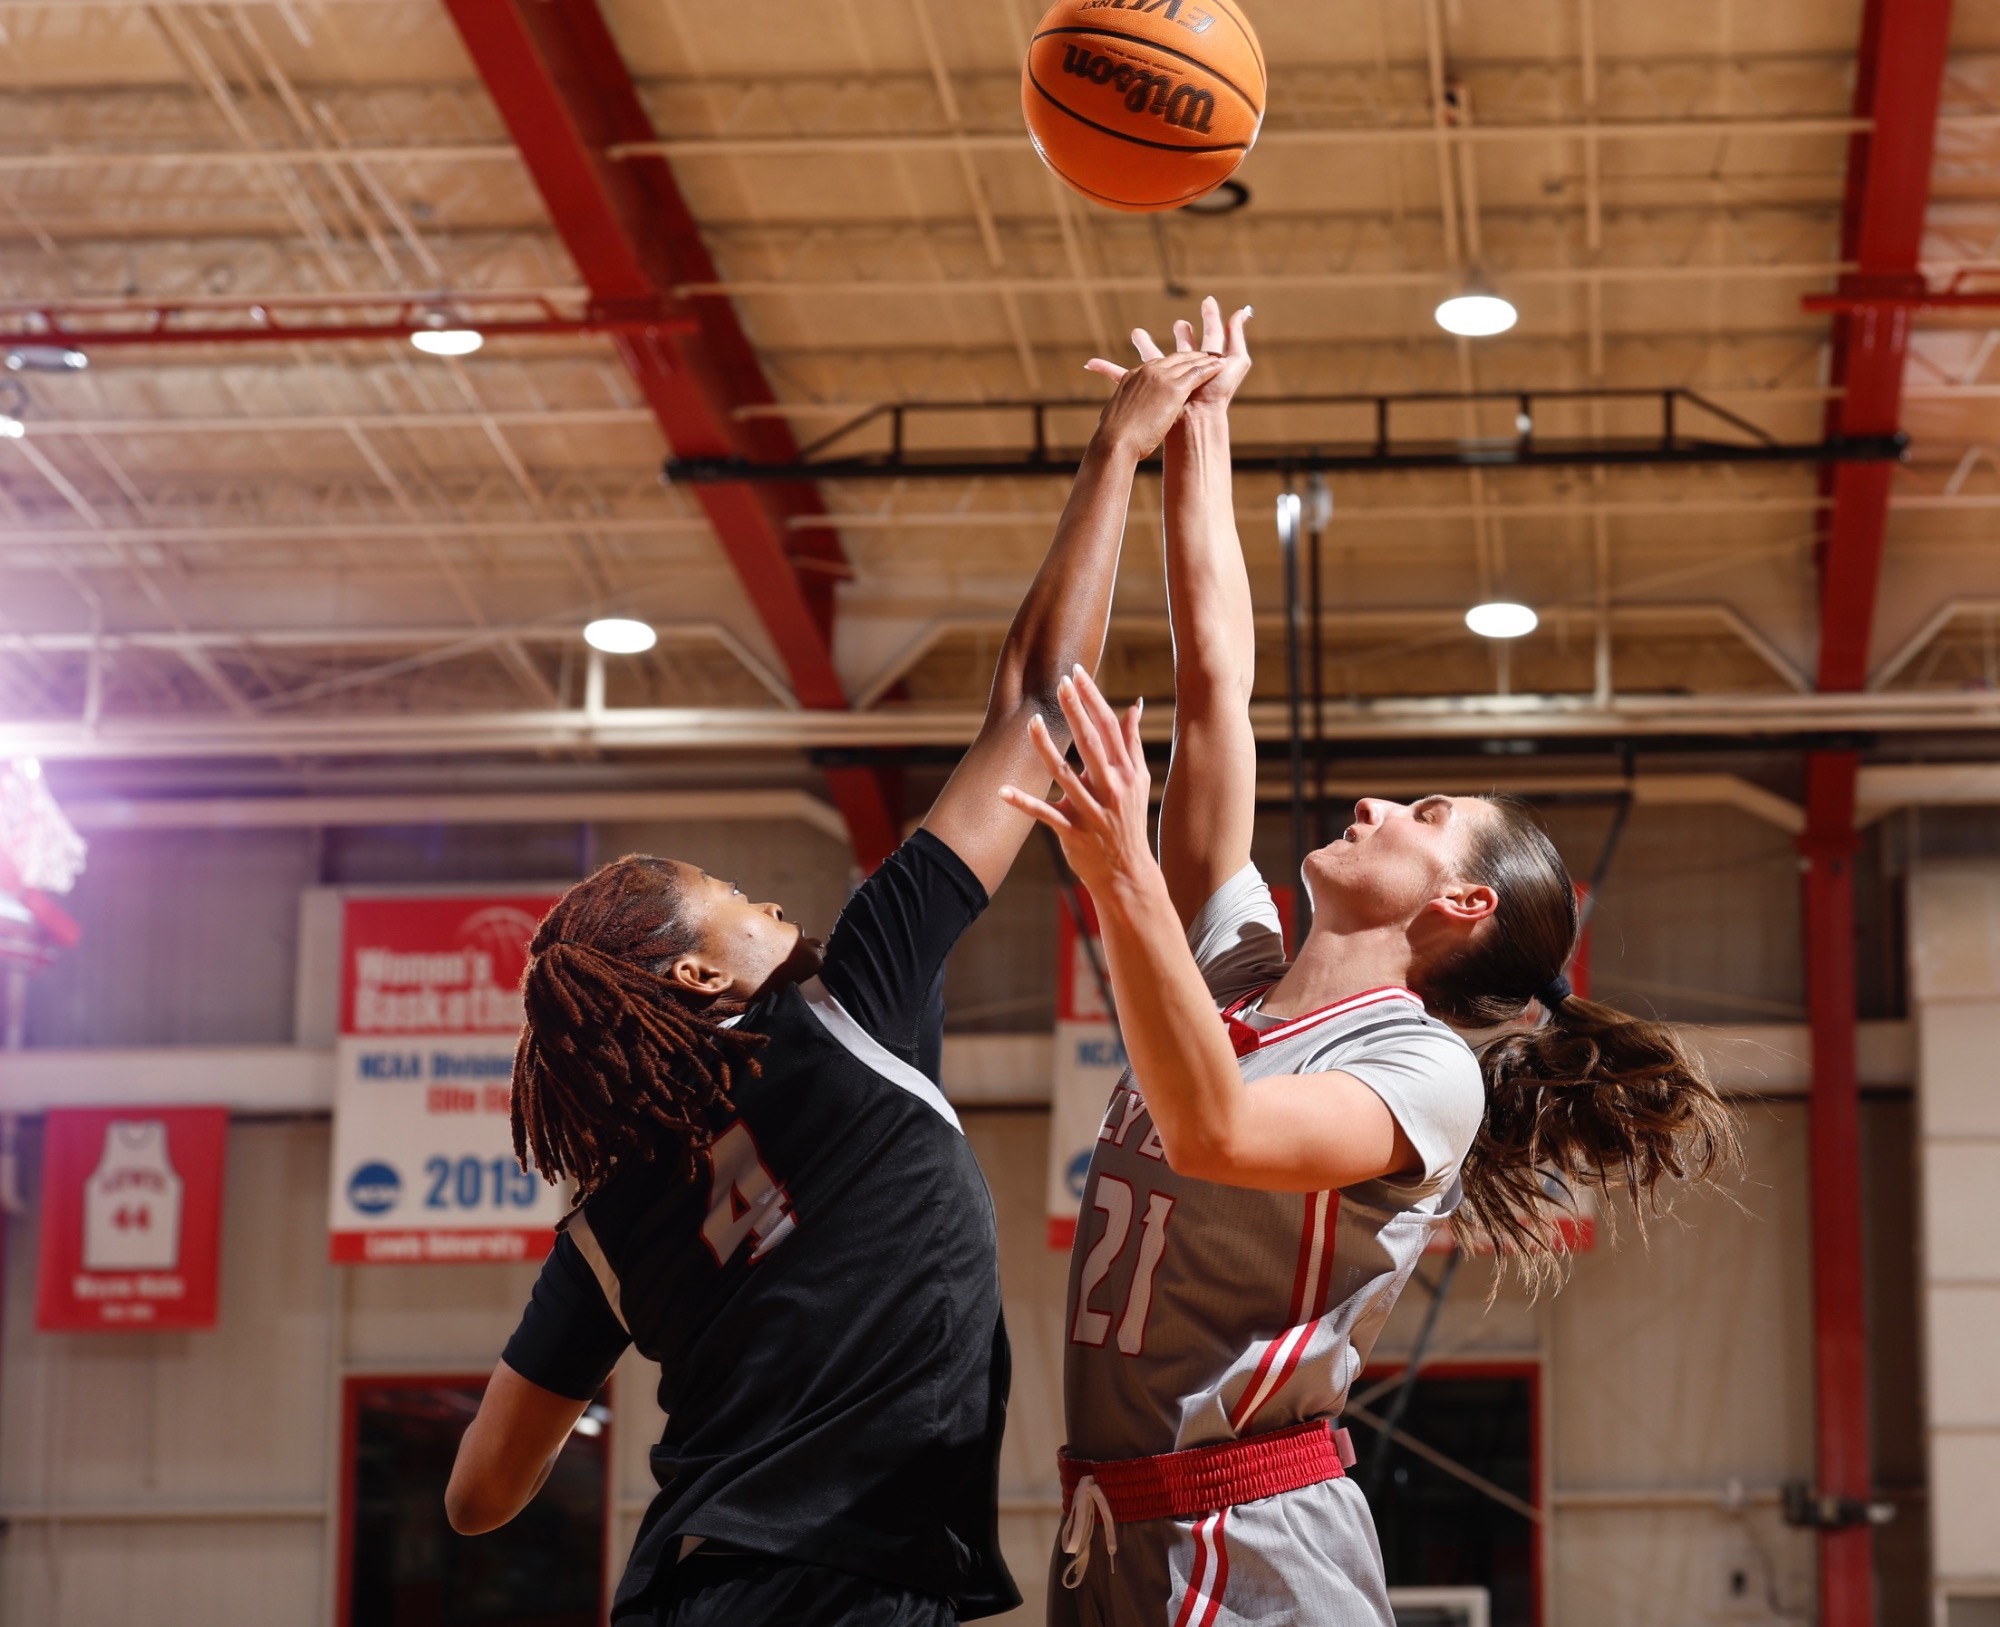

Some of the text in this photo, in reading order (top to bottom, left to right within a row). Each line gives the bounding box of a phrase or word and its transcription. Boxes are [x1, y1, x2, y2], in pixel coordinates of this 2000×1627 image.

[1063, 43, 1216, 134] Wilson
[356, 946, 493, 984] Women's
[355, 983, 524, 1030] Basketba
[359, 1053, 421, 1079] NCAA
[424, 1155, 537, 1210] 2015
[699, 1117, 798, 1270] 4
[110, 1205, 152, 1232] 44
[1069, 1172, 1176, 1357] 21
